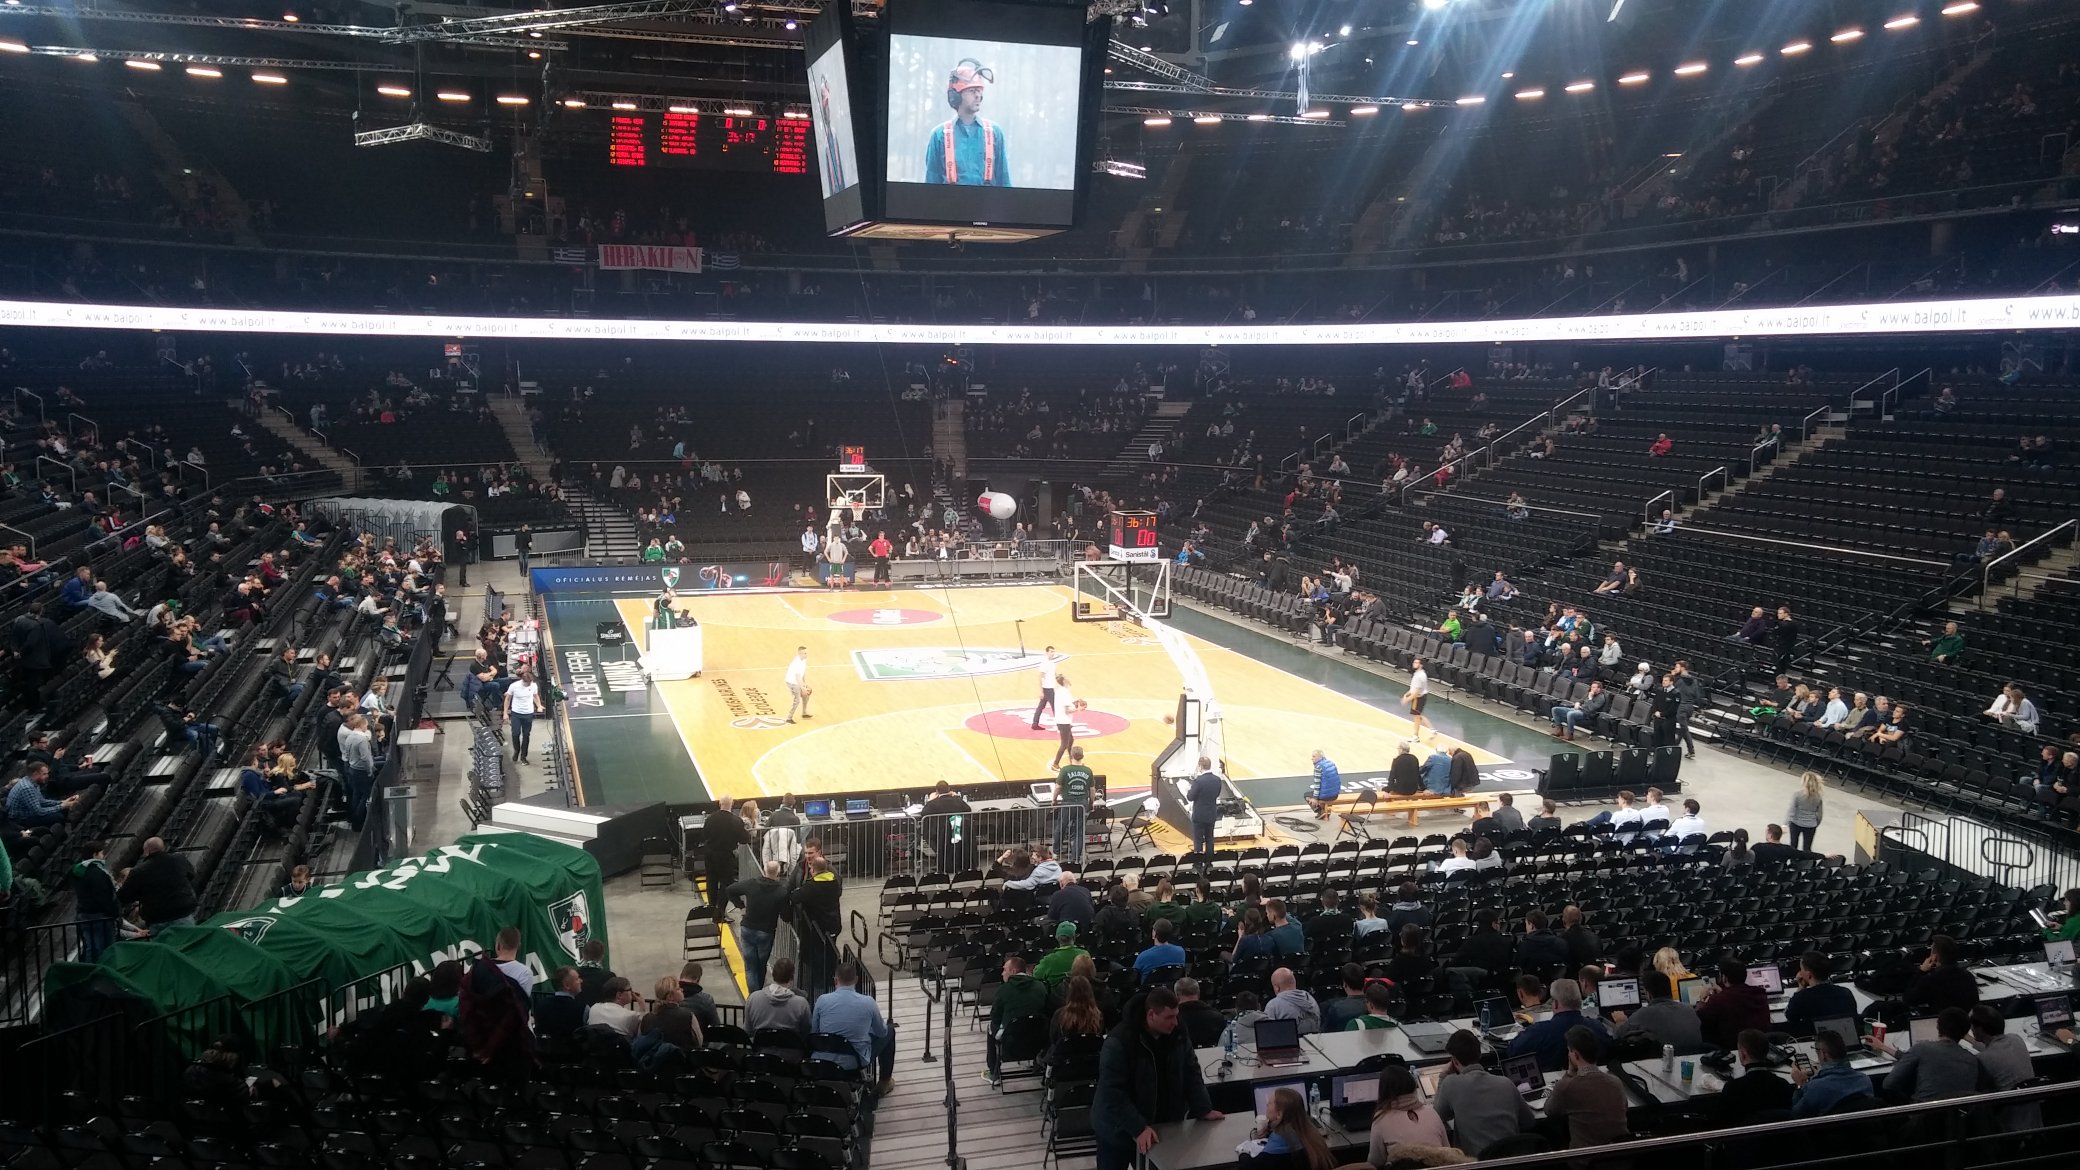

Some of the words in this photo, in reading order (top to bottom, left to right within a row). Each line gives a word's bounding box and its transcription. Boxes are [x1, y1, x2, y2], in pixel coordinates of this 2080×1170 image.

[1879, 307, 1967, 328] www.balpol.lt
[1127, 516, 1157, 528] 36:17
[1137, 529, 1156, 546] 00
[555, 576, 609, 584] OFICIALUS
